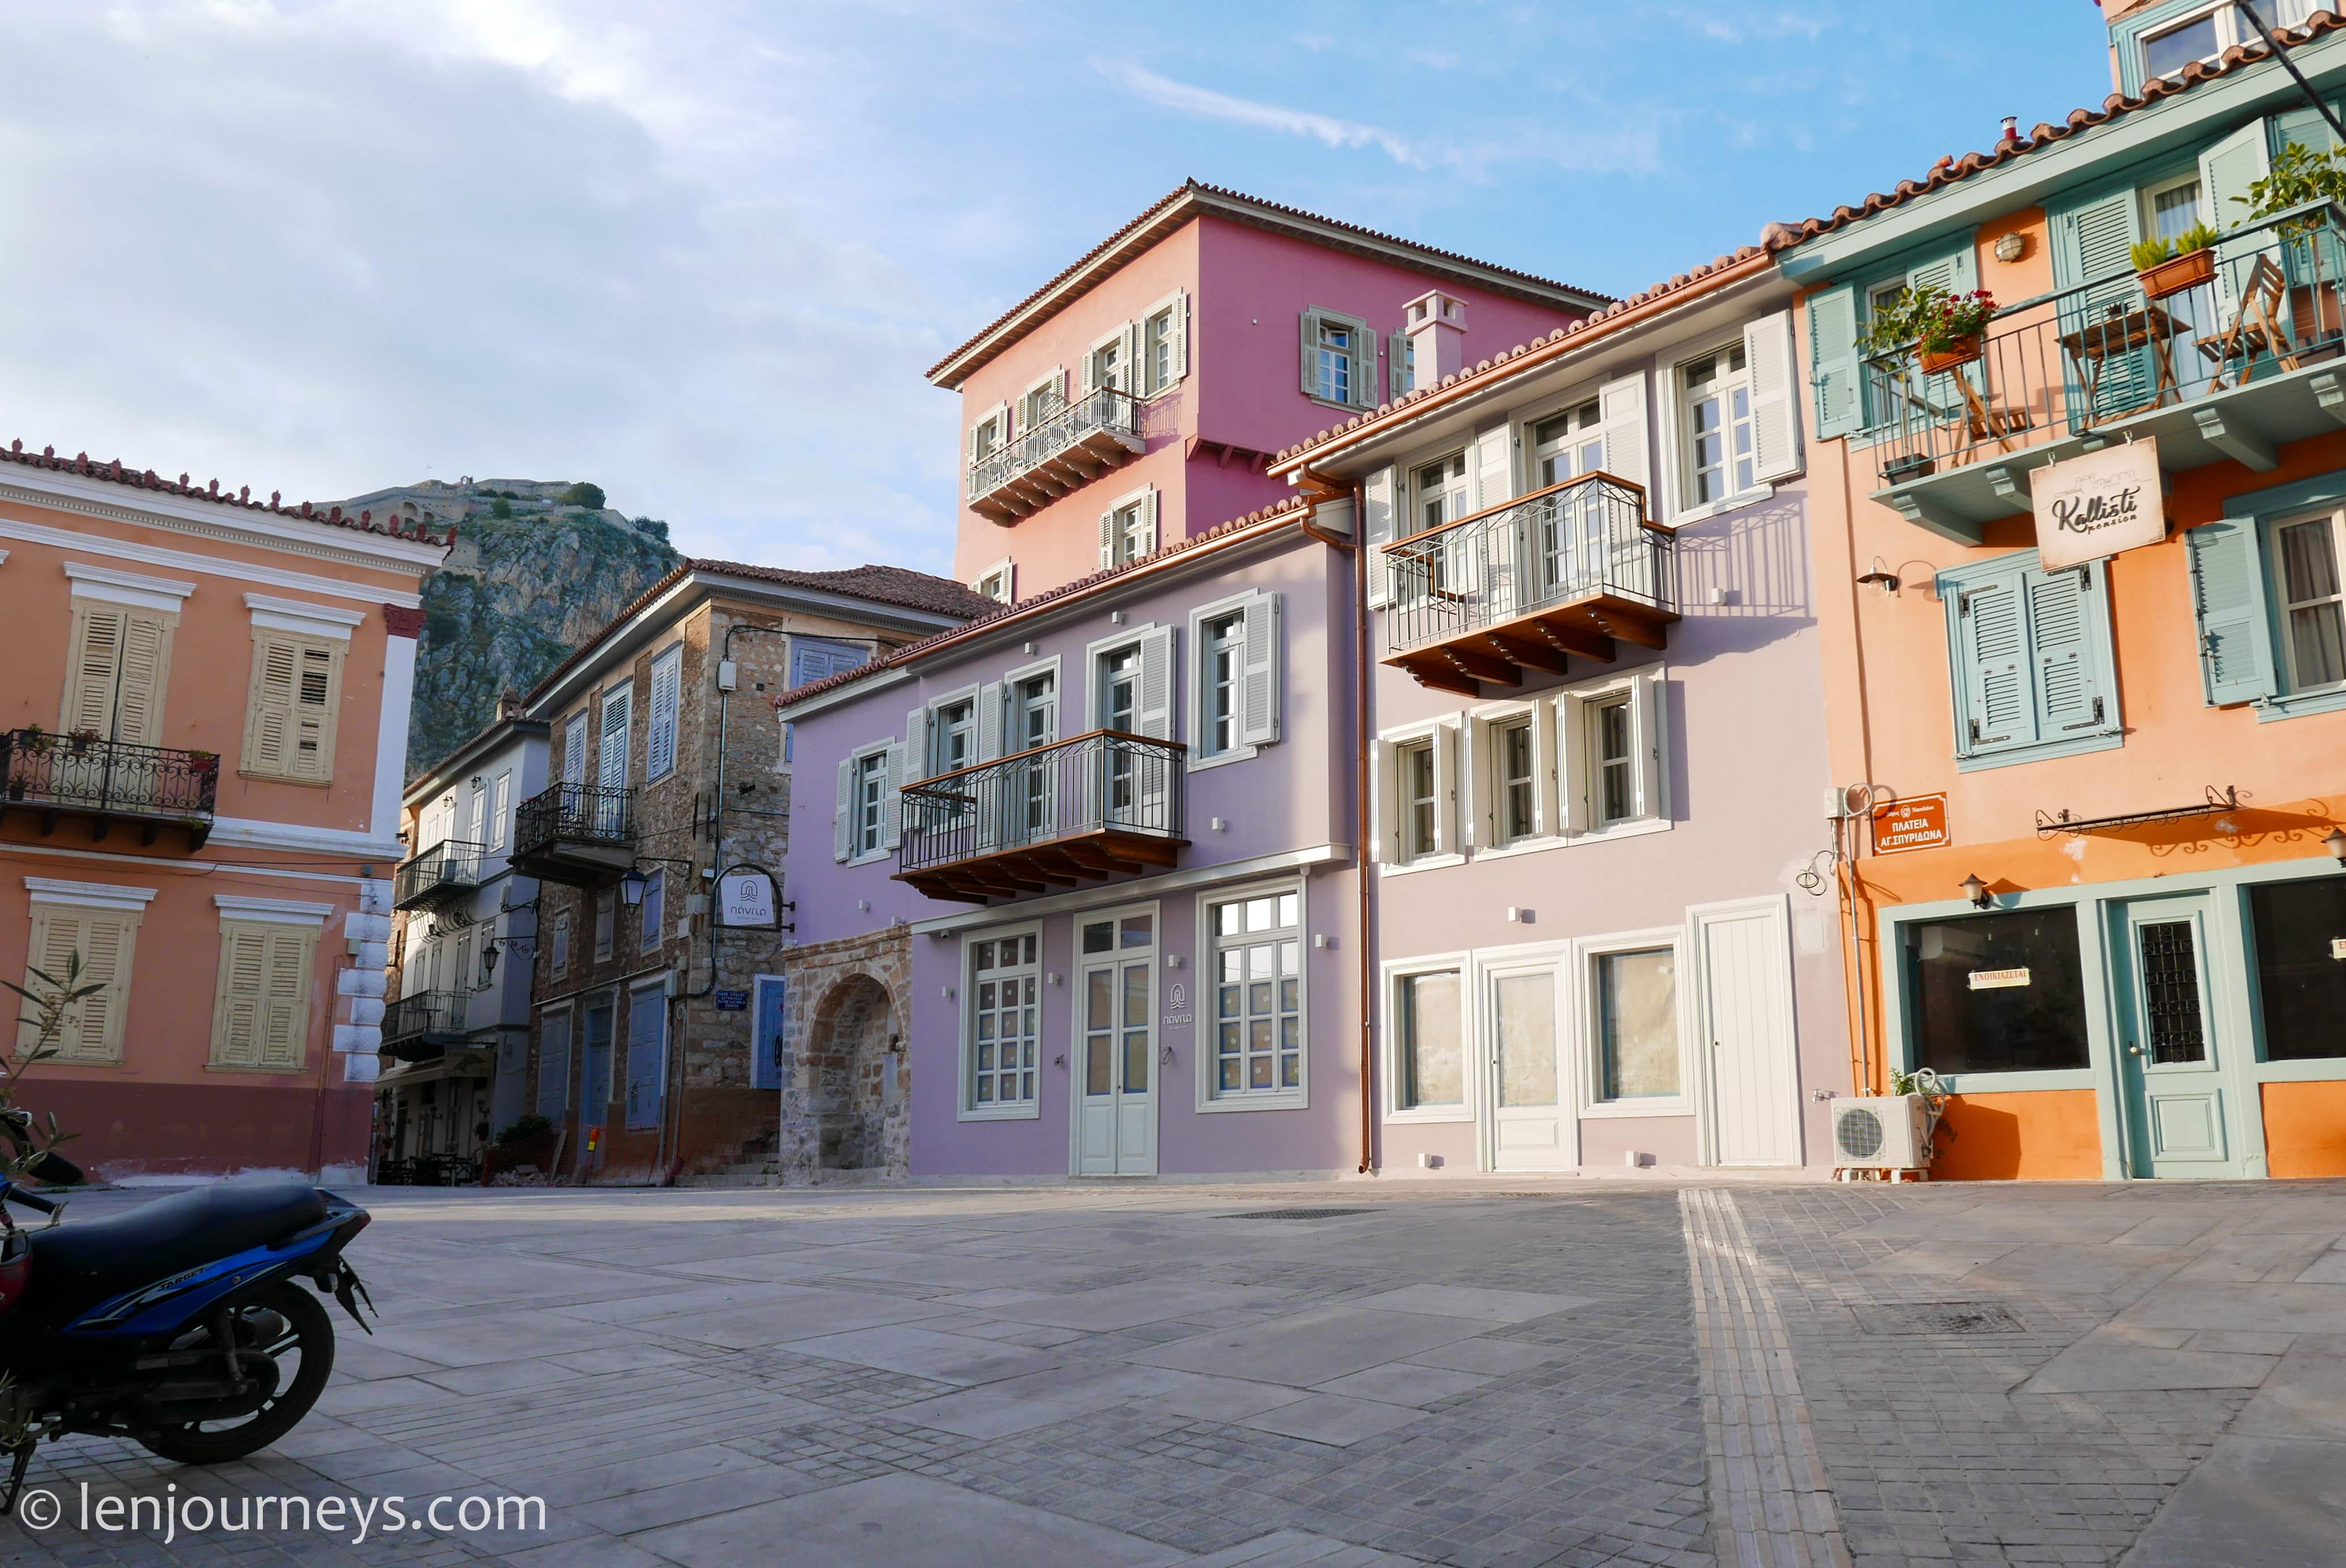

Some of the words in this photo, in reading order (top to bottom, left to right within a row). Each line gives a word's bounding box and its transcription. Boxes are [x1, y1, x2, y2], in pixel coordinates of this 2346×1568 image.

[2051, 485, 2140, 533] Kallisti
[2087, 513, 2138, 535] pension
[1892, 818, 1929, 832] ΠΛΑΤΕΙΑ
[1880, 829, 1942, 847] ΑΓ.ΣΠΥΡΙΔΩΝΑ
[1974, 971, 2026, 981] ΕΝΟΙΚΙΑΖΕΤΑΙ
[157, 1267, 206, 1292] TARGET
